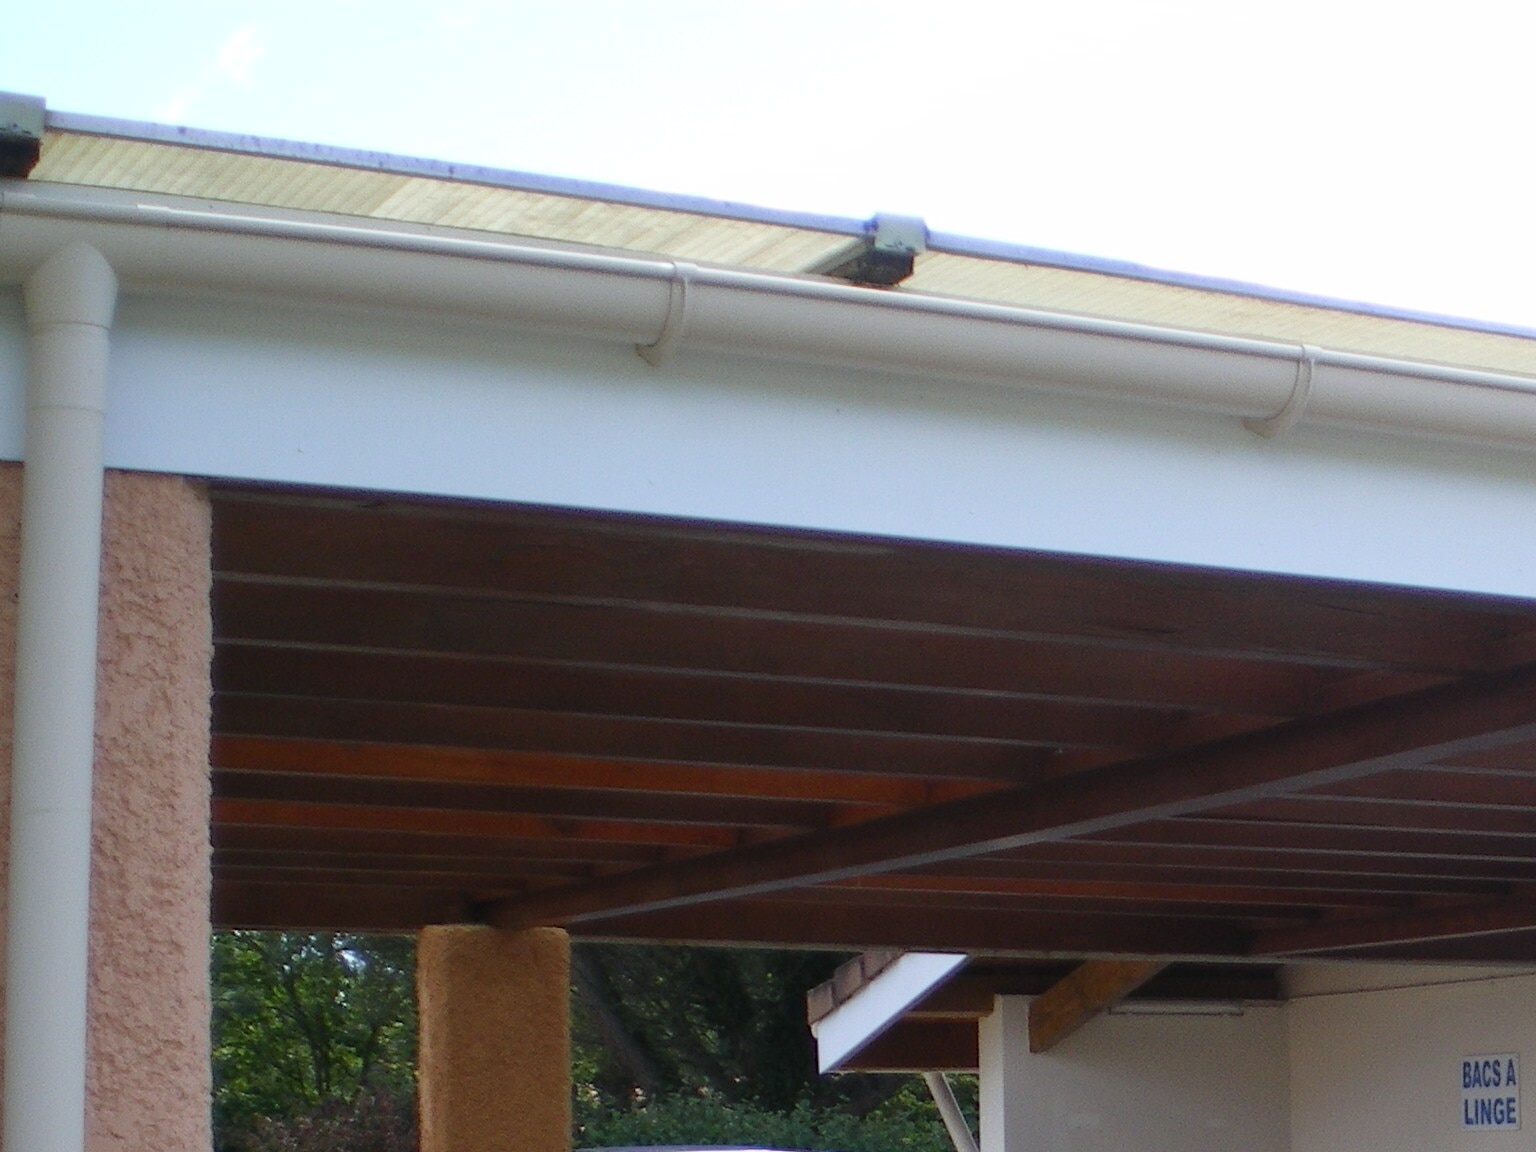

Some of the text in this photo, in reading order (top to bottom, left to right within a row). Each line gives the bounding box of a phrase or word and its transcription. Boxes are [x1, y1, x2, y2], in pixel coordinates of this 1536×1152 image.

[1463, 1058, 1516, 1088] BACS A
[1464, 1097, 1516, 1125] LINGE
